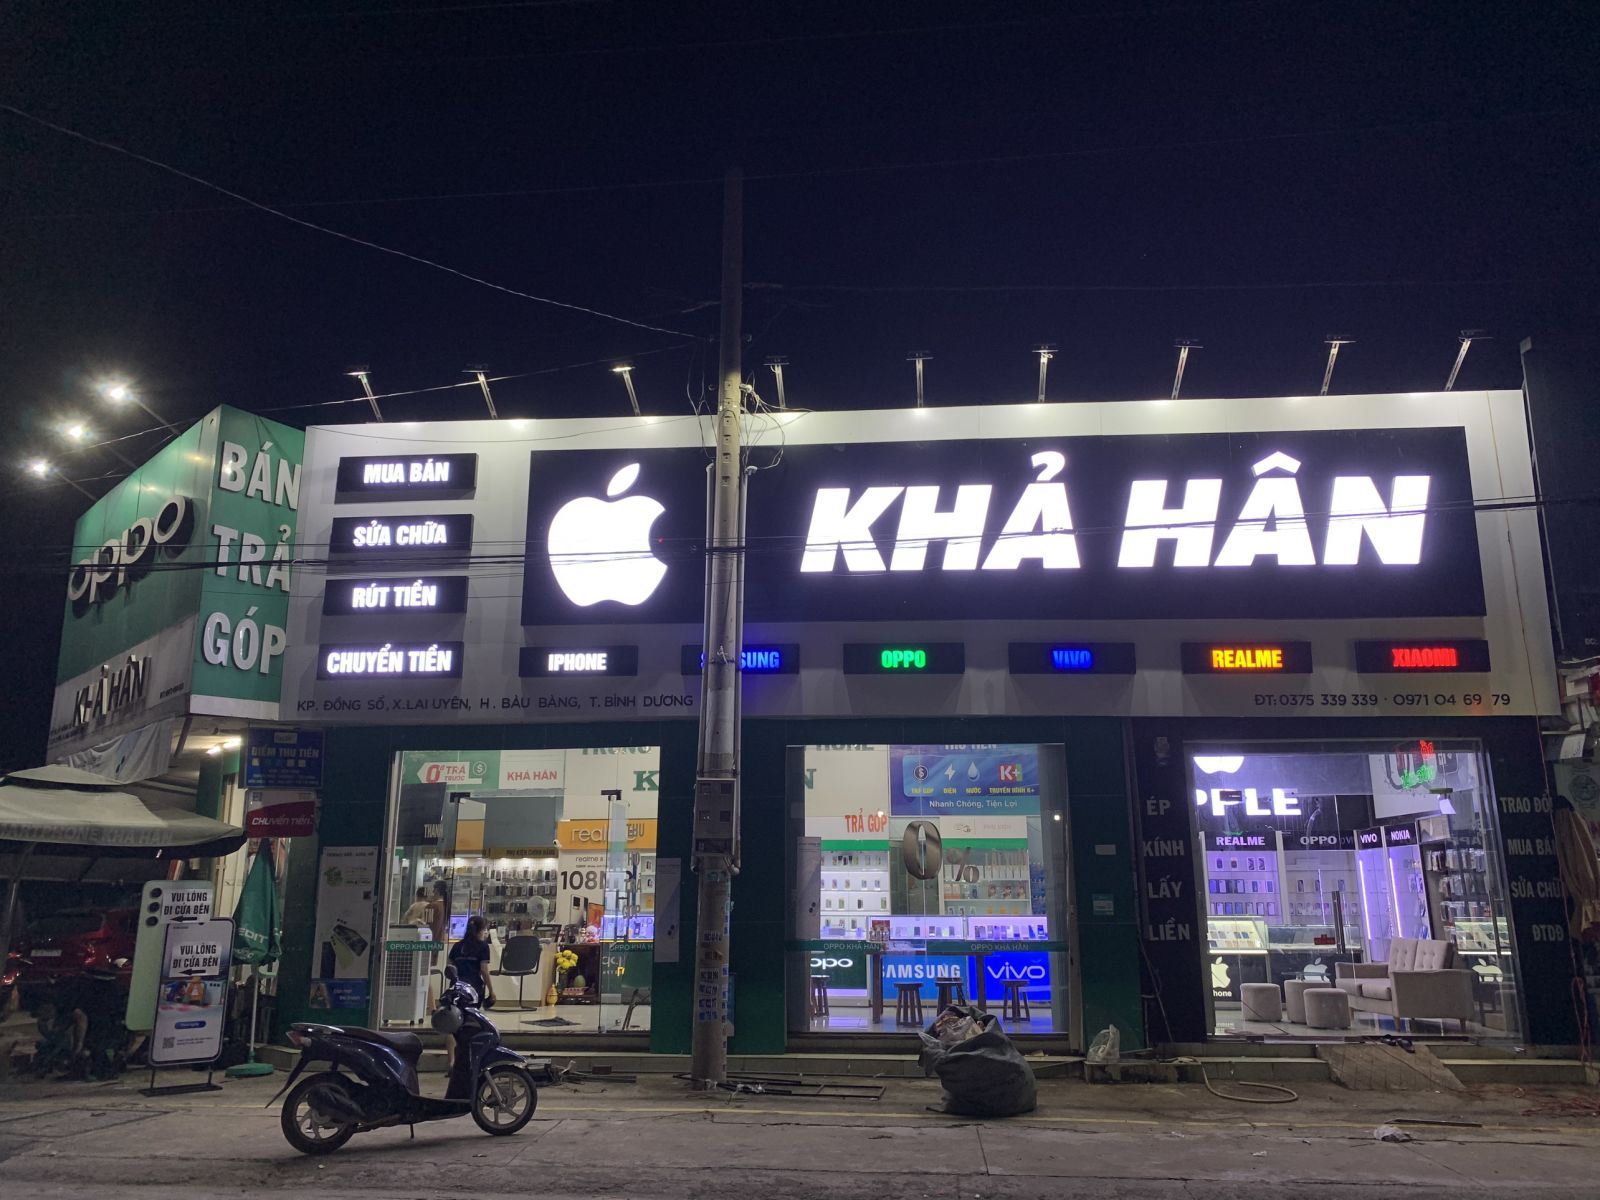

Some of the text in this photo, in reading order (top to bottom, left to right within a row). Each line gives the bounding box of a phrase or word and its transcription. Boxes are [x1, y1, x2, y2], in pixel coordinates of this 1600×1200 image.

[219, 441, 301, 510] BÁN
[363, 458, 450, 484] MUA BÁN
[800, 450, 1431, 572] KHẢ HÂN
[353, 519, 448, 547] SỬA CHỮA
[213, 523, 291, 592] TRẢ
[352, 579, 437, 608] RÚT TIỀN
[203, 606, 287, 674] GÓP
[326, 643, 452, 674] CHUYỂN TIỀN
[548, 653, 608, 671] IPHONE
[881, 650, 927, 668] OPPO
[1051, 650, 1094, 669] VIVO
[1212, 649, 1283, 668] REALME
[1391, 648, 1457, 668] XIAOMI
[297, 700, 319, 712] KP.
[501, 695, 530, 709] BÀU
[538, 694, 581, 709] BÀNG,
[643, 694, 694, 707] DƯƠNG
[1321, 694, 1347, 706] 339
[1351, 694, 1378, 705] 339
[1393, 694, 1429, 706] 0971
[1434, 694, 1456, 705] 04
[1464, 694, 1482, 705] 69
[1491, 694, 1511, 705] 79
[956, 800, 984, 809] Chóng,
[986, 800, 1002, 809] Tiện
[1004, 800, 1018, 808] Lợi
[1146, 796, 1171, 815] ÉP
[1502, 797, 1531, 813] TRAO
[844, 808, 865, 833] TRẢ
[1216, 836, 1266, 846] REALME
[1300, 835, 1337, 845] OPPO
[1360, 833, 1377, 844] VIVO
[1390, 829, 1411, 841] NOKIA
[1142, 836, 1185, 856] KÍNH
[1507, 839, 1533, 855] MUA
[171, 890, 208, 902] VUI LÒNG
[1148, 875, 1182, 898] LẤY
[1510, 875, 1535, 898] SỬA
[163, 906, 172, 915] ĐI
[193, 903, 210, 914] BÊN
[1149, 917, 1190, 941] LIỀN
[180, 942, 217, 955] VUI LÒNG
[970, 943, 993, 951] OPPO
[172, 959, 181, 969] ĐI
[202, 956, 219, 967] BÊN
